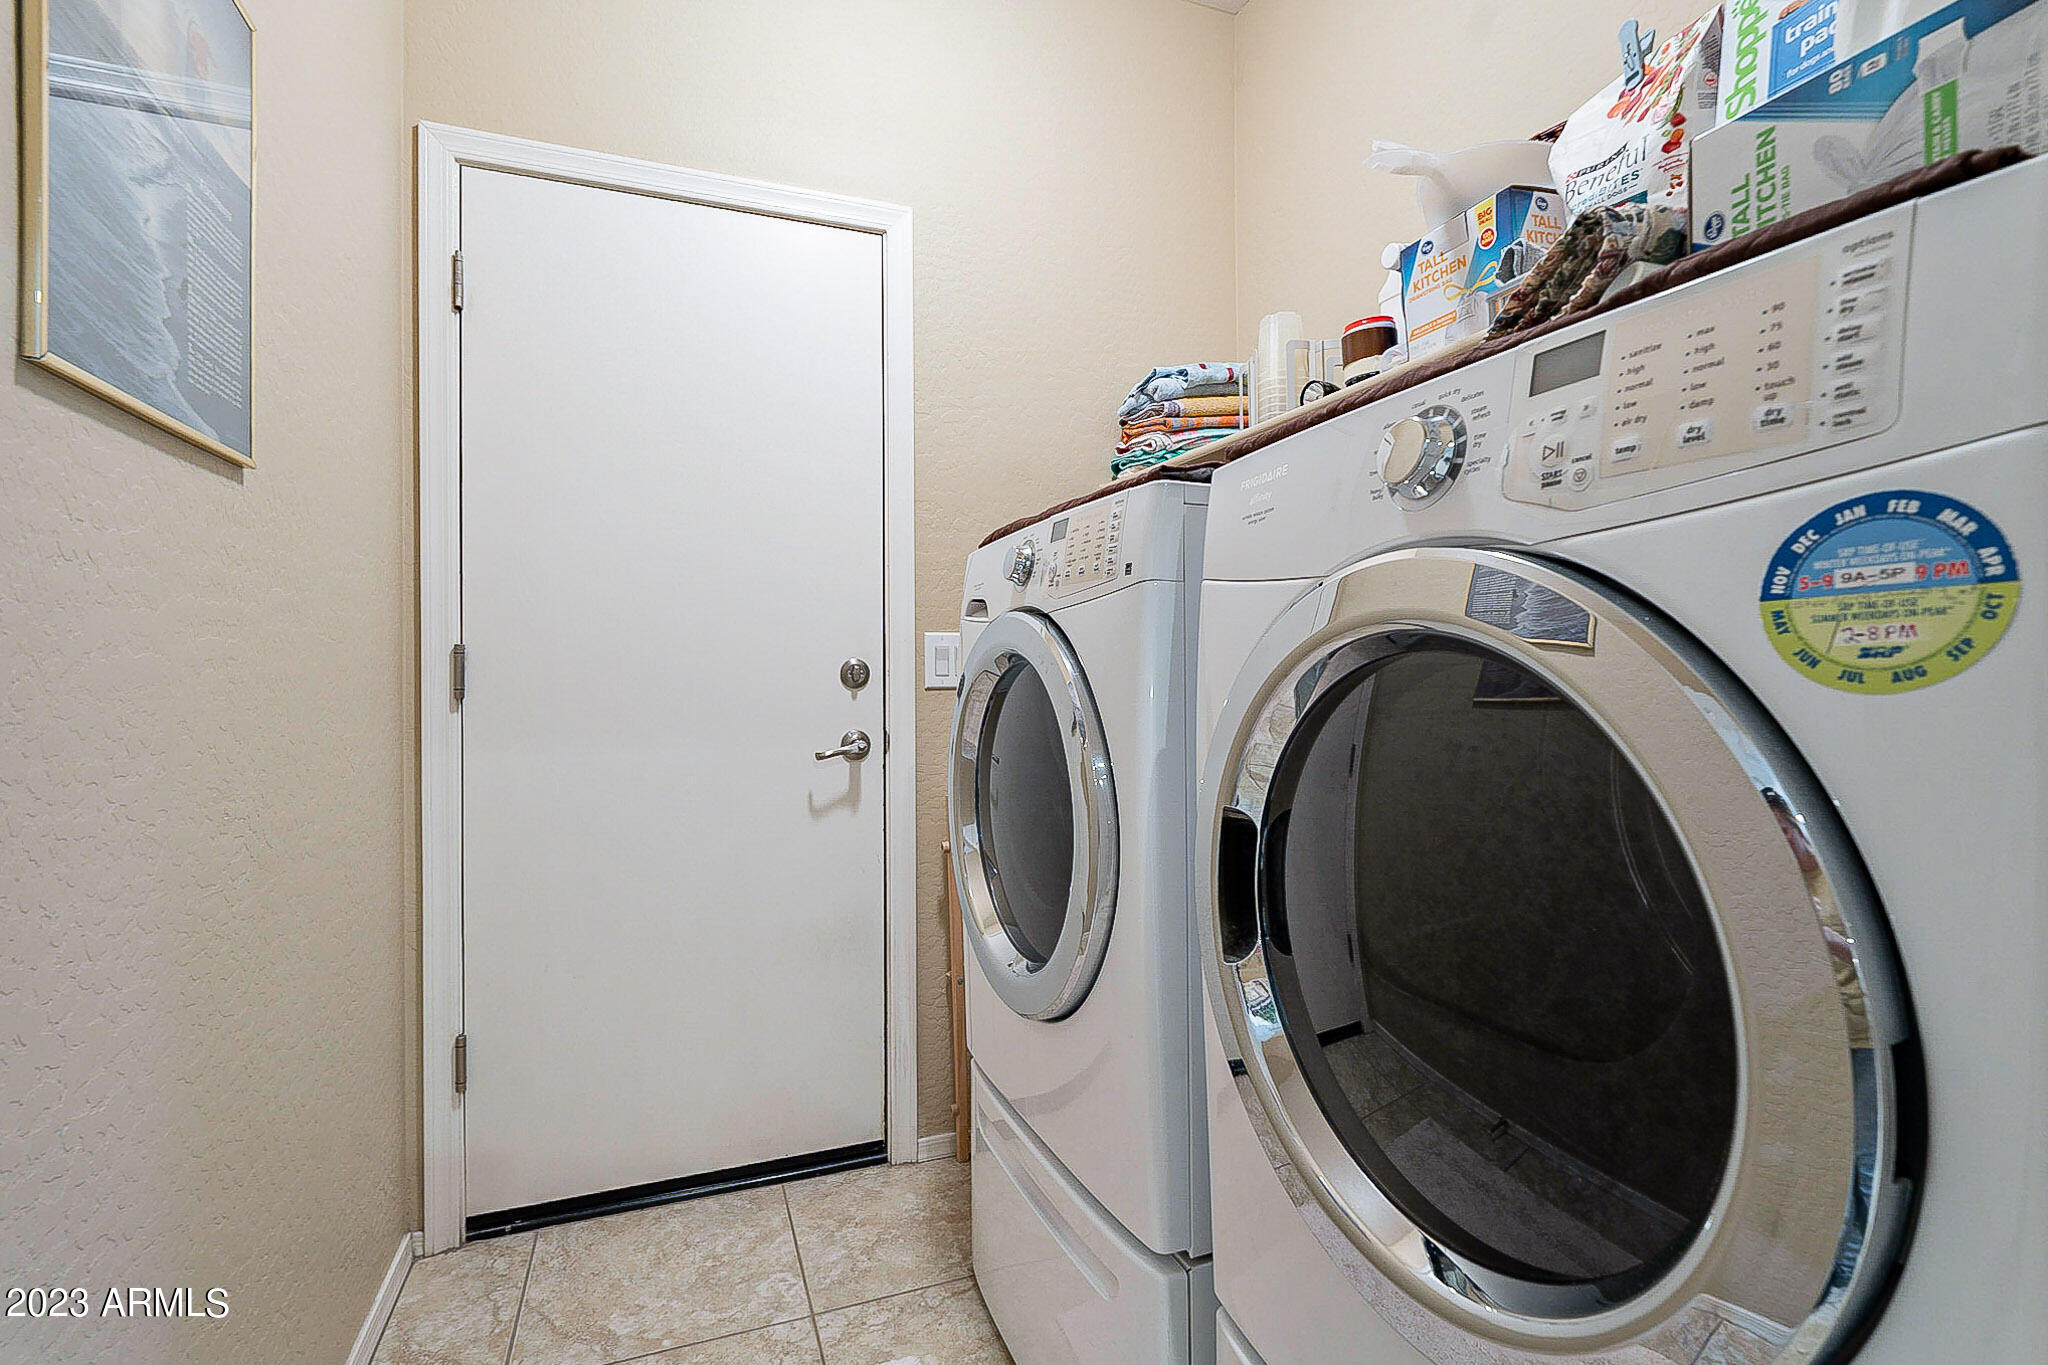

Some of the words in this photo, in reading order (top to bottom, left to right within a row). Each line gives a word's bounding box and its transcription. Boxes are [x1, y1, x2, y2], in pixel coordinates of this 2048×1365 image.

[1565, 134, 1650, 205] Beneful
[1756, 125, 1777, 228] ITCHEN
[1478, 206, 1493, 220] BIG
[1731, 173, 1751, 238] TALL
[1531, 214, 1562, 230] TALL
[1412, 254, 1467, 294] KITCHEN
[1417, 251, 1449, 274] TALL
[1692, 356, 1725, 373] normal
[1624, 378, 1654, 392] normal
[1240, 463, 1289, 491] FRIGIDAIRE
[1834, 504, 1867, 526] JAN
[1886, 499, 1921, 514] FEB
[1936, 508, 1978, 536] MAR
[1976, 546, 2006, 577] APR
[1769, 566, 1792, 594] NOV
[1790, 529, 1821, 554] DEC
[1914, 564, 1929, 580] 9
[1932, 560, 1970, 578] PM
[1770, 609, 1791, 635] MAY
[1792, 648, 1822, 669] JUN
[1837, 669, 1866, 684] JUL
[1891, 665, 1928, 683] AUG
[1946, 637, 1975, 661] SEP
[1980, 593, 2005, 620] OCT
[1884, 624, 1919, 639] PM
